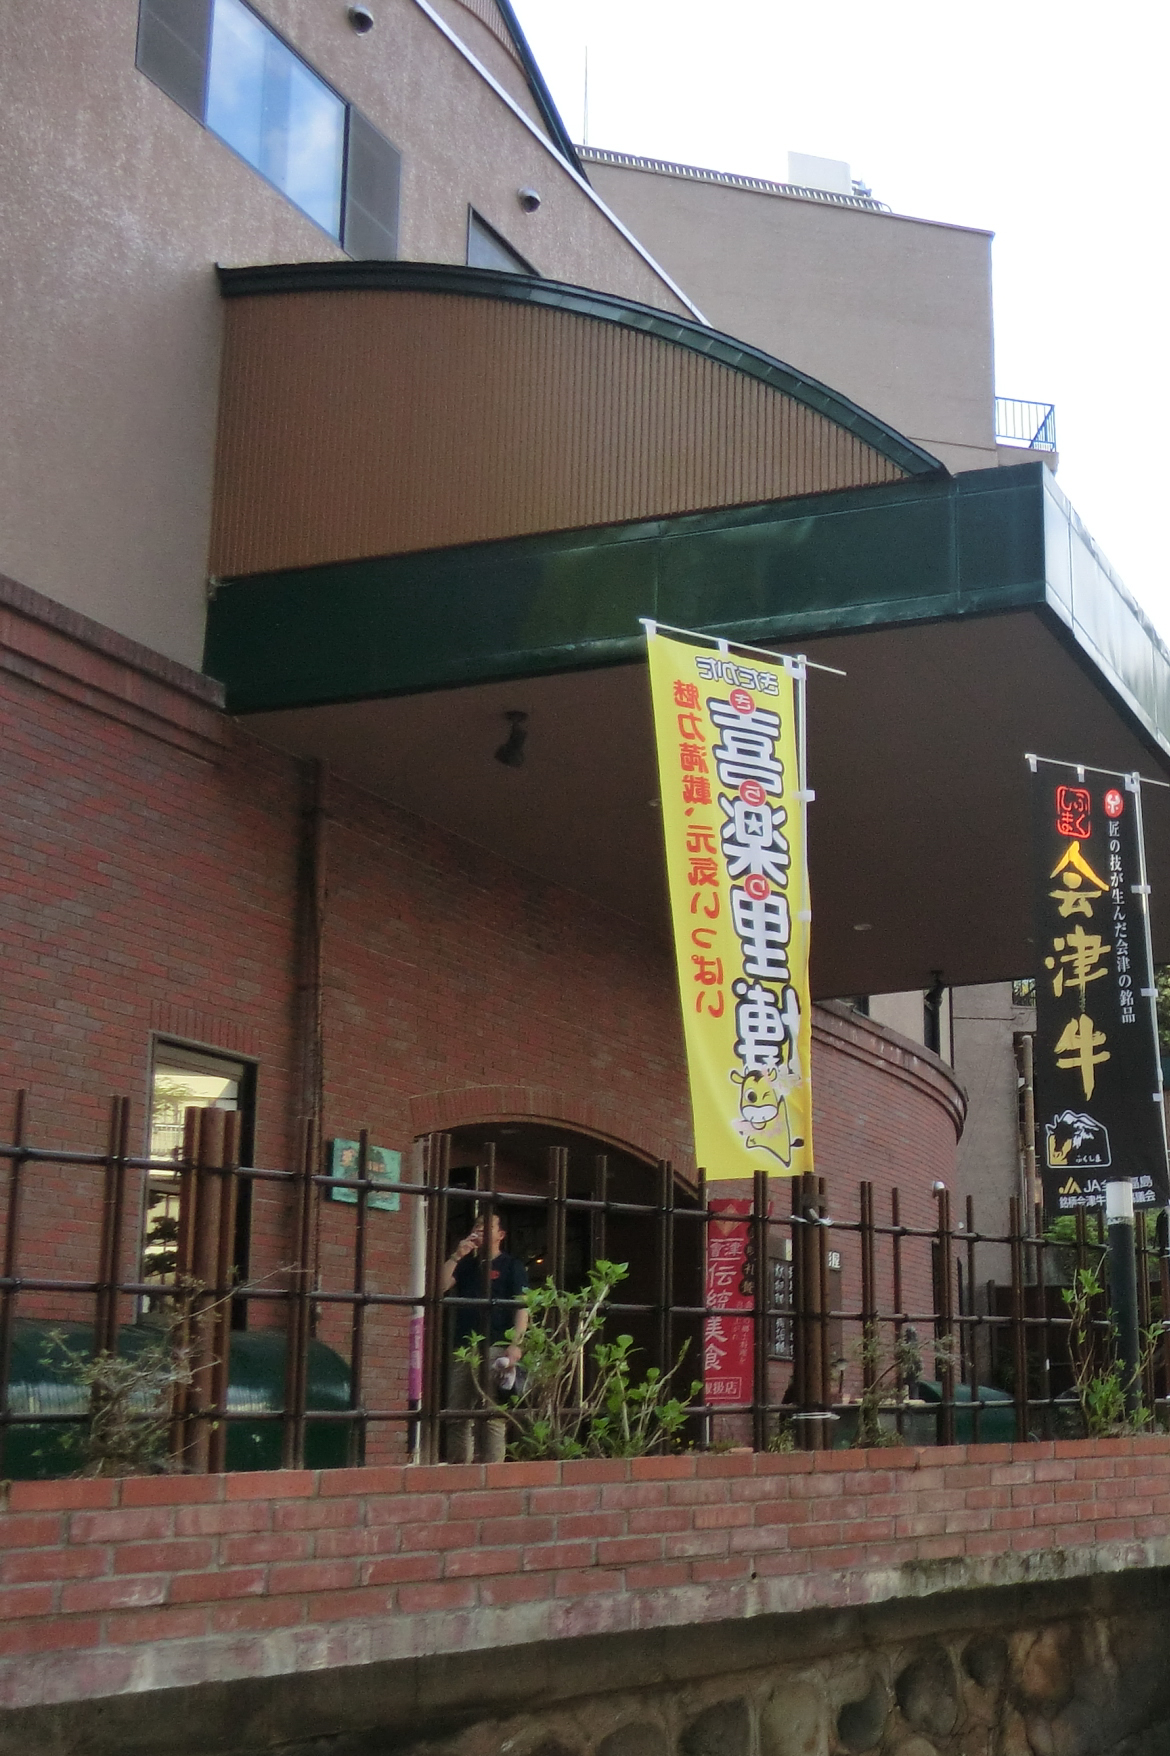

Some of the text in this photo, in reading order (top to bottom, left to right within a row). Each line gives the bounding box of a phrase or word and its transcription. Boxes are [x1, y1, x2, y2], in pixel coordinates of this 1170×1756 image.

[1044, 840, 1112, 1101] 会津牛
[1108, 820, 1136, 1024] 匠の技が生んだ会津の銘品
[705, 1262, 737, 1371] 伝統美食
